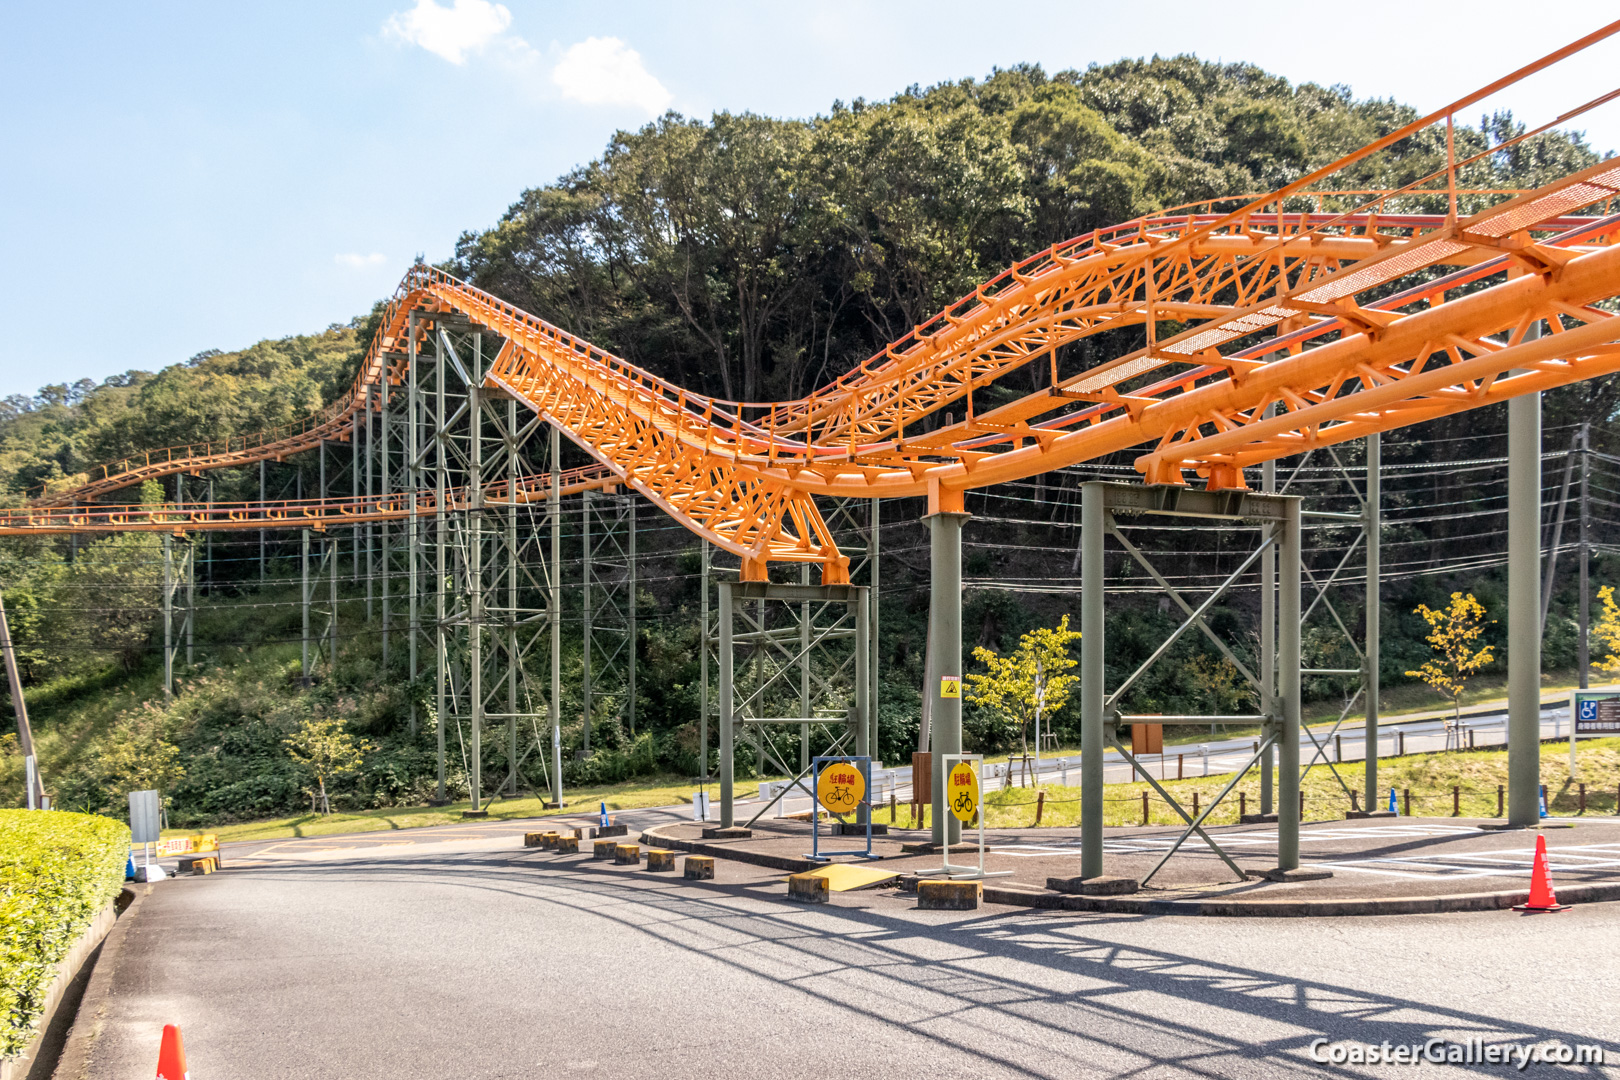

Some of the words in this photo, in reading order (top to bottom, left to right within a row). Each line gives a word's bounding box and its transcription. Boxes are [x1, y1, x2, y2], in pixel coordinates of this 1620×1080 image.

[829, 772, 855, 786] 駐輪場
[954, 772, 972, 787] 駐輪場
